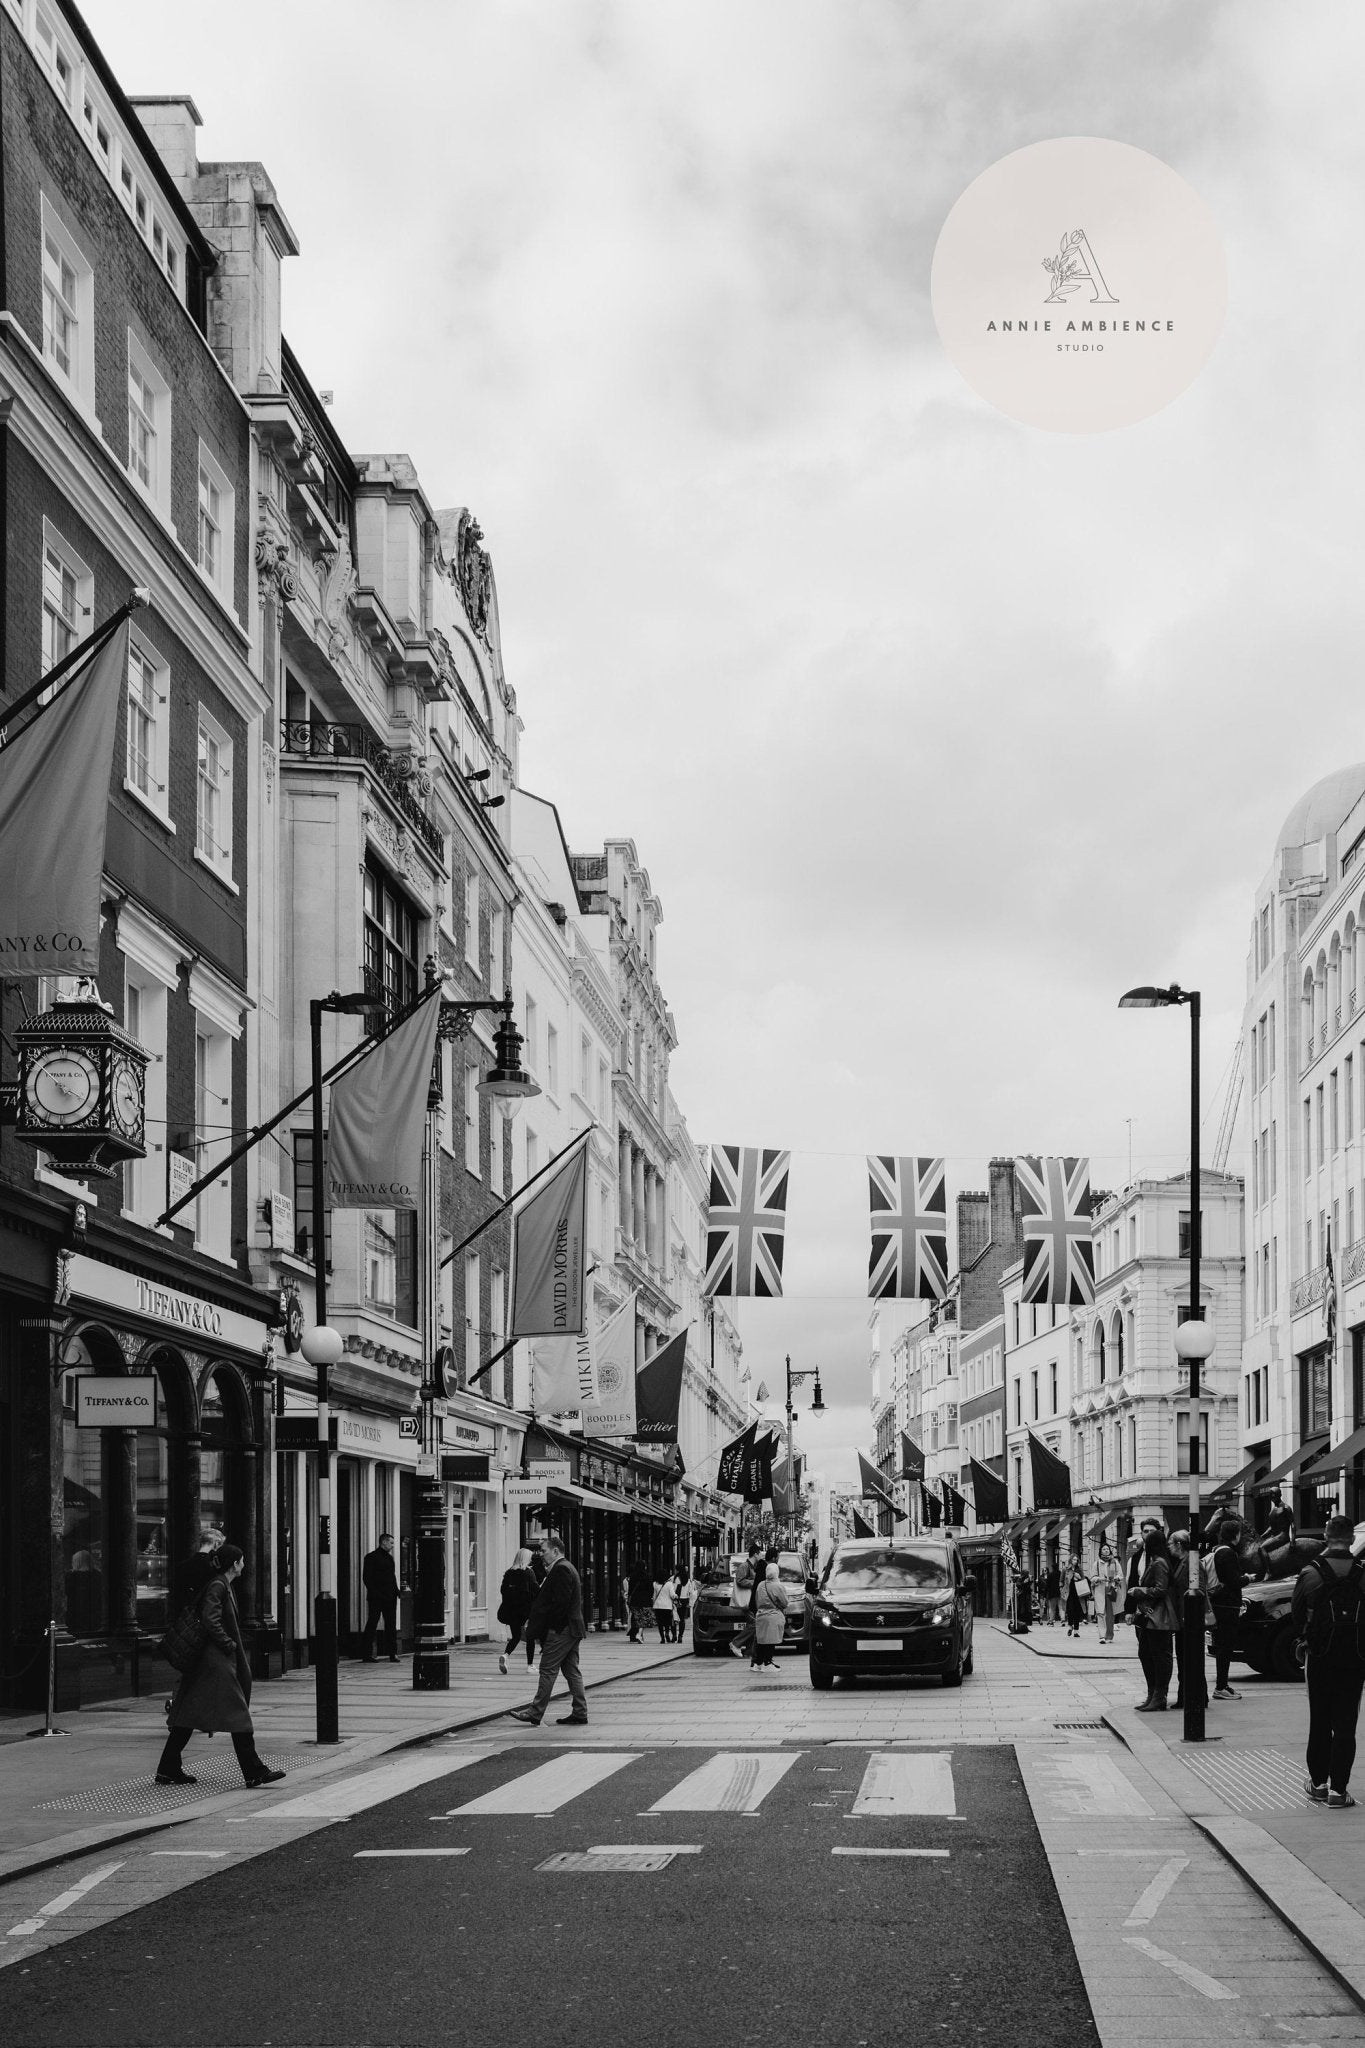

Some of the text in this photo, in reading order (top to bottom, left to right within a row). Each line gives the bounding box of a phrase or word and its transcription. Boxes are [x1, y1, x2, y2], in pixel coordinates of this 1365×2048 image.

[329, 1181, 378, 1195] TIFFANY
[553, 1218, 568, 1328] DAVID MORRIS
[136, 1279, 192, 1325] TIFFANY
[84, 1396, 124, 1406] TIFFANY
[587, 1413, 631, 1424] BOODLES
[637, 1417, 677, 1432] Cartier
[343, 1420, 361, 1438] DAVID
[750, 1458, 758, 1492] CHANEL
